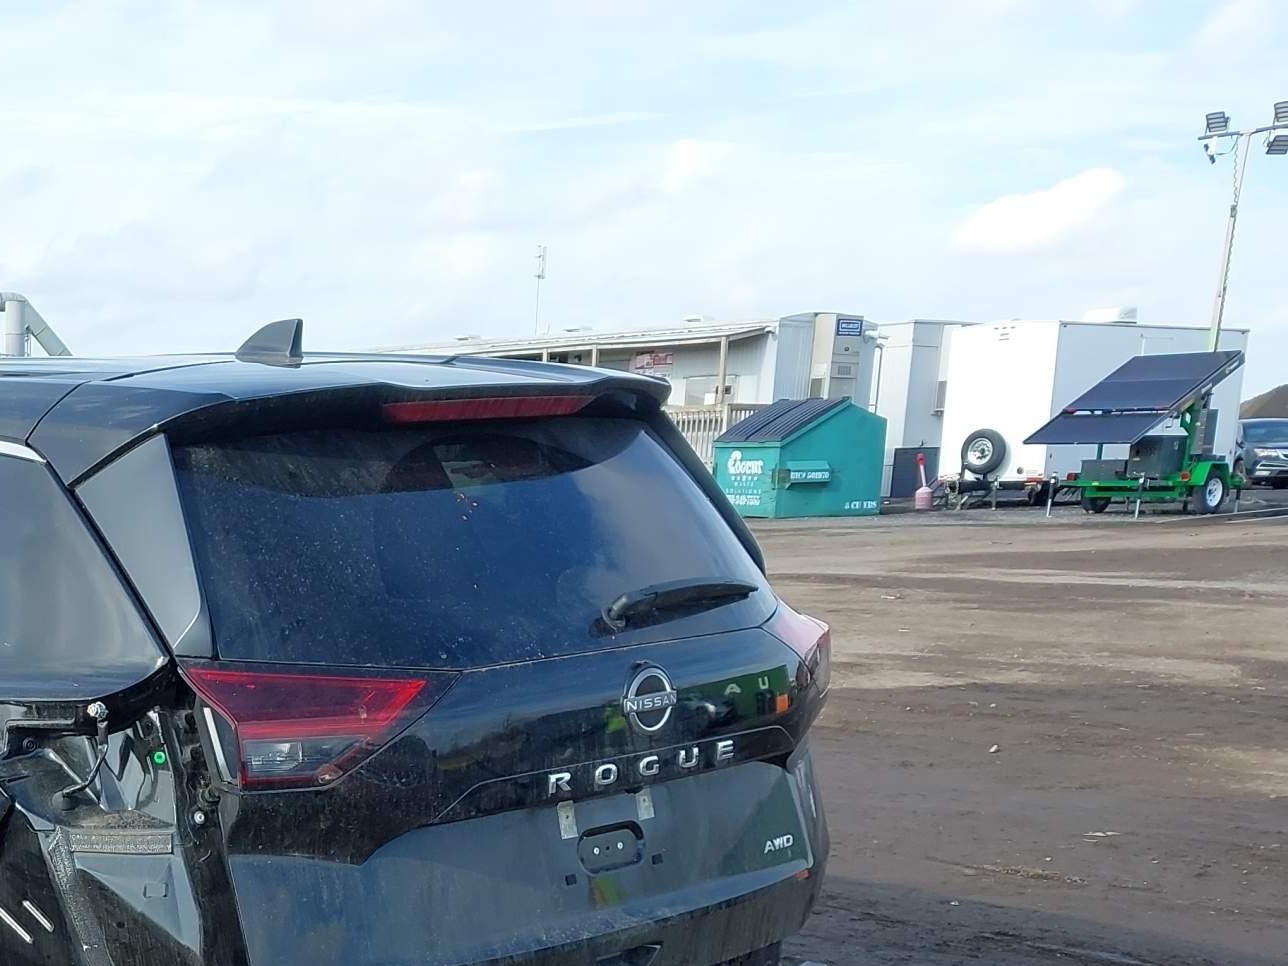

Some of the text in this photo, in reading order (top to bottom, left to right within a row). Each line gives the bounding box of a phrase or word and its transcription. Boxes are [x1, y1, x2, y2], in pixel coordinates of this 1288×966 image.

[624, 690, 677, 713] NISSAN
[548, 739, 735, 795] ROGUE
[763, 834, 794, 854] AWD
